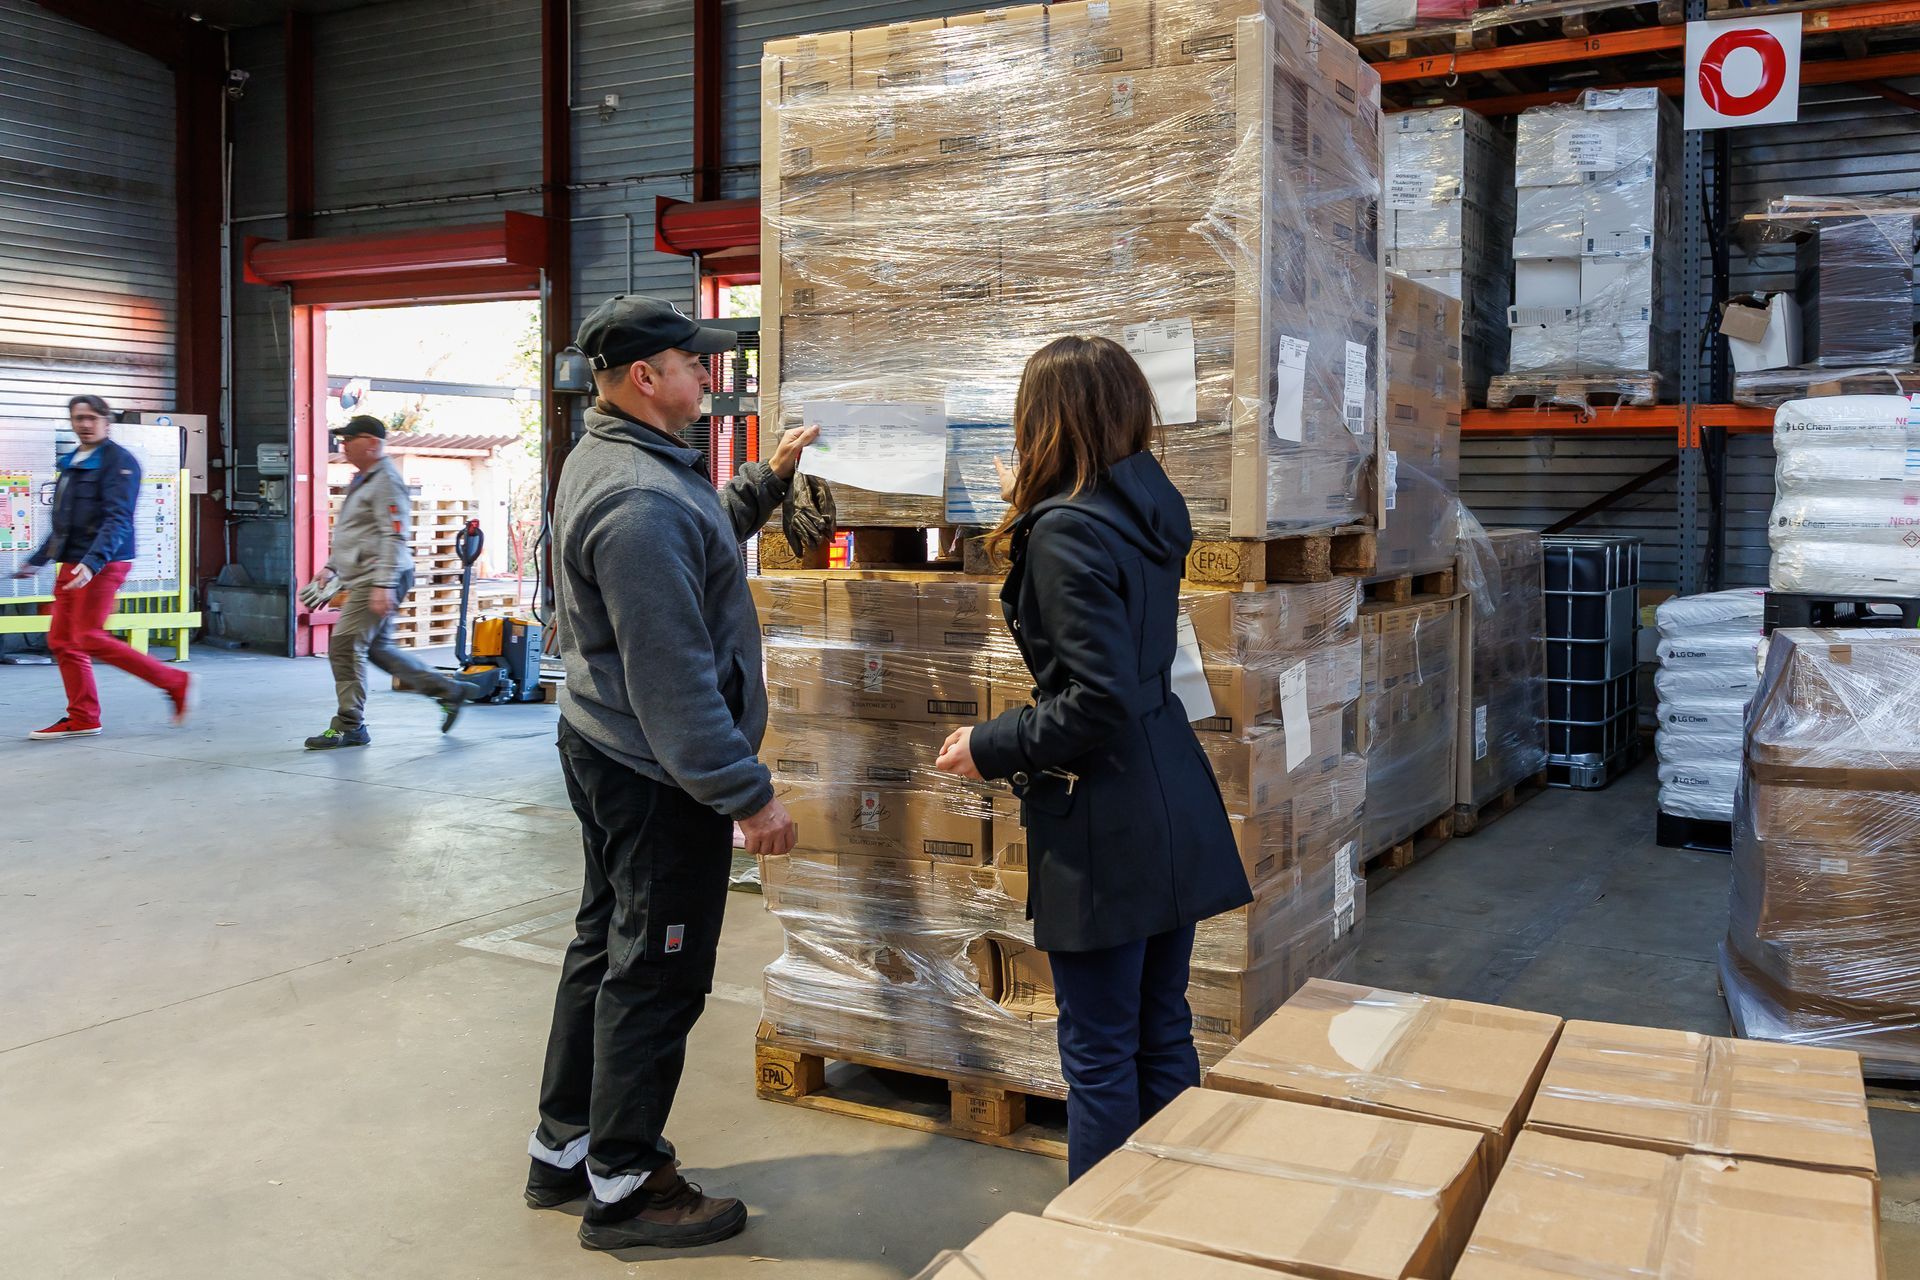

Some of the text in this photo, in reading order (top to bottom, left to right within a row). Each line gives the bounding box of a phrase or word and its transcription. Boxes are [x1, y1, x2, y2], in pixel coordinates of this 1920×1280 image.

[1583, 40, 1600, 52] 16
[1418, 61, 1433, 73] 17
[1698, 28, 1787, 117] O
[1573, 412, 1589, 424] 13
[1792, 423, 1805, 431] LG
[1806, 422, 1832, 431] Chem
[1801, 519, 1826, 529] Chem
[1200, 552, 1233, 570] EPAL
[762, 1068, 787, 1087] EPAL
